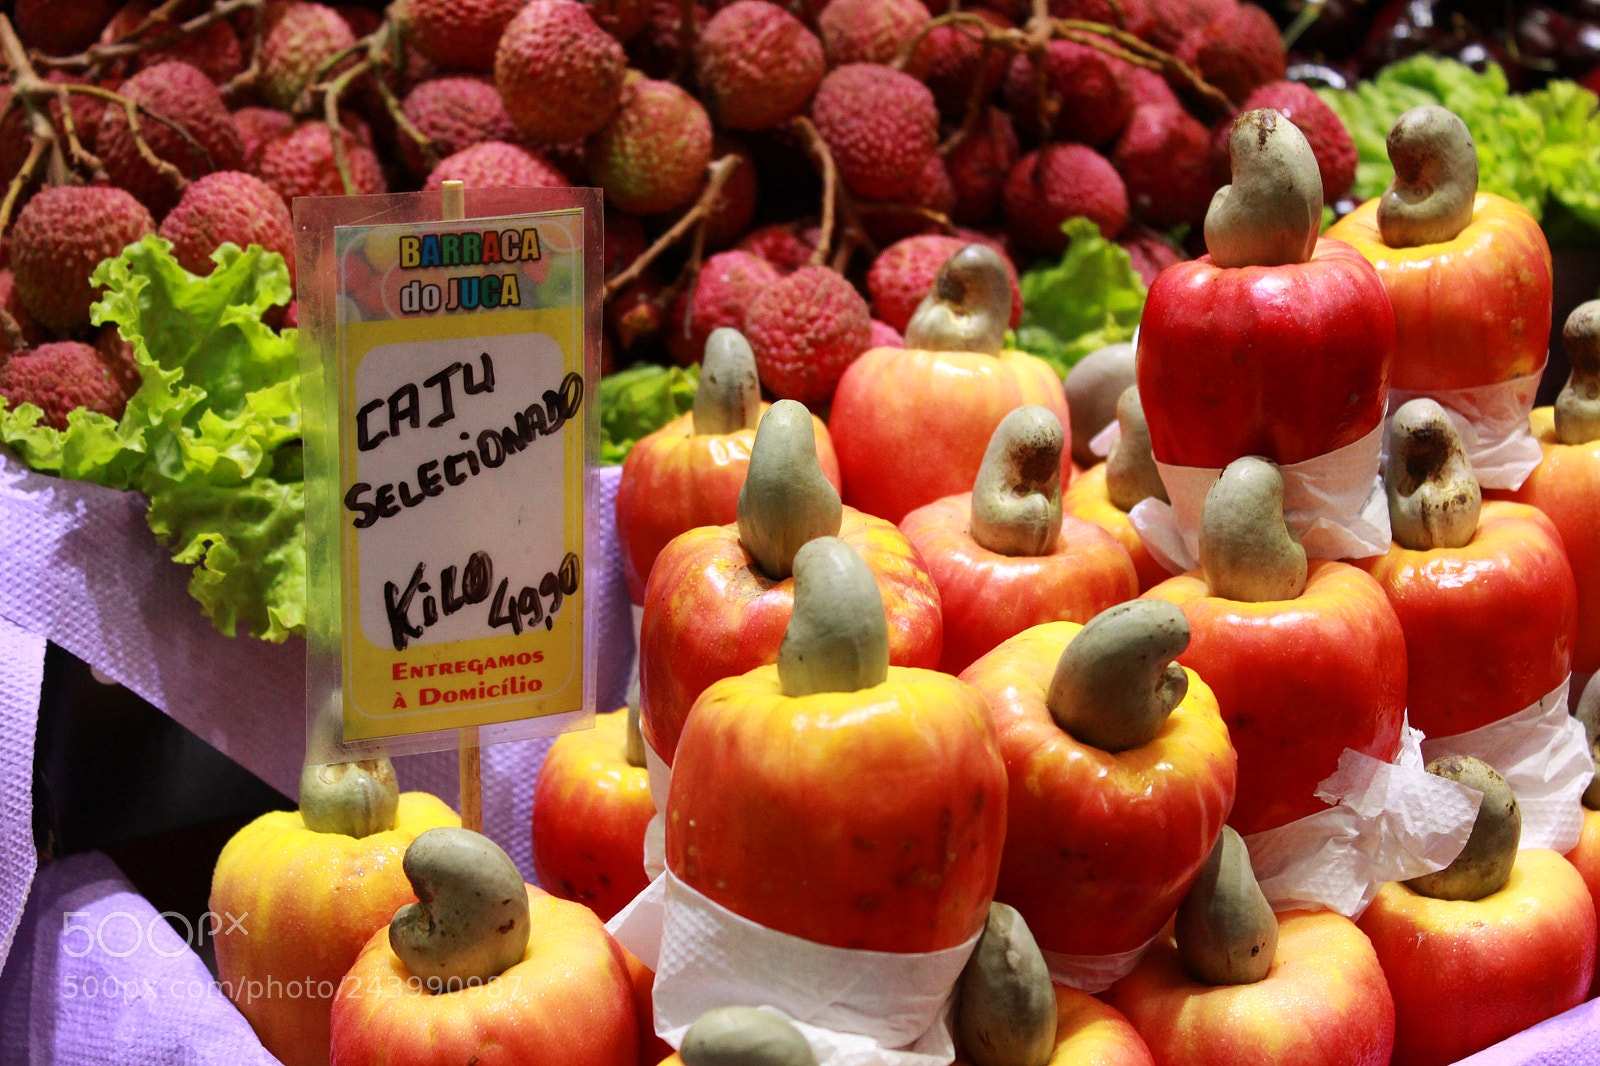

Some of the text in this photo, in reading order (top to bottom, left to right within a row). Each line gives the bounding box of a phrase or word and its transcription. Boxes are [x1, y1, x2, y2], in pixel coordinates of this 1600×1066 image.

[400, 228, 541, 269] BARRACA
[400, 274, 521, 313] do JUCA
[356, 352, 496, 452] CAJU
